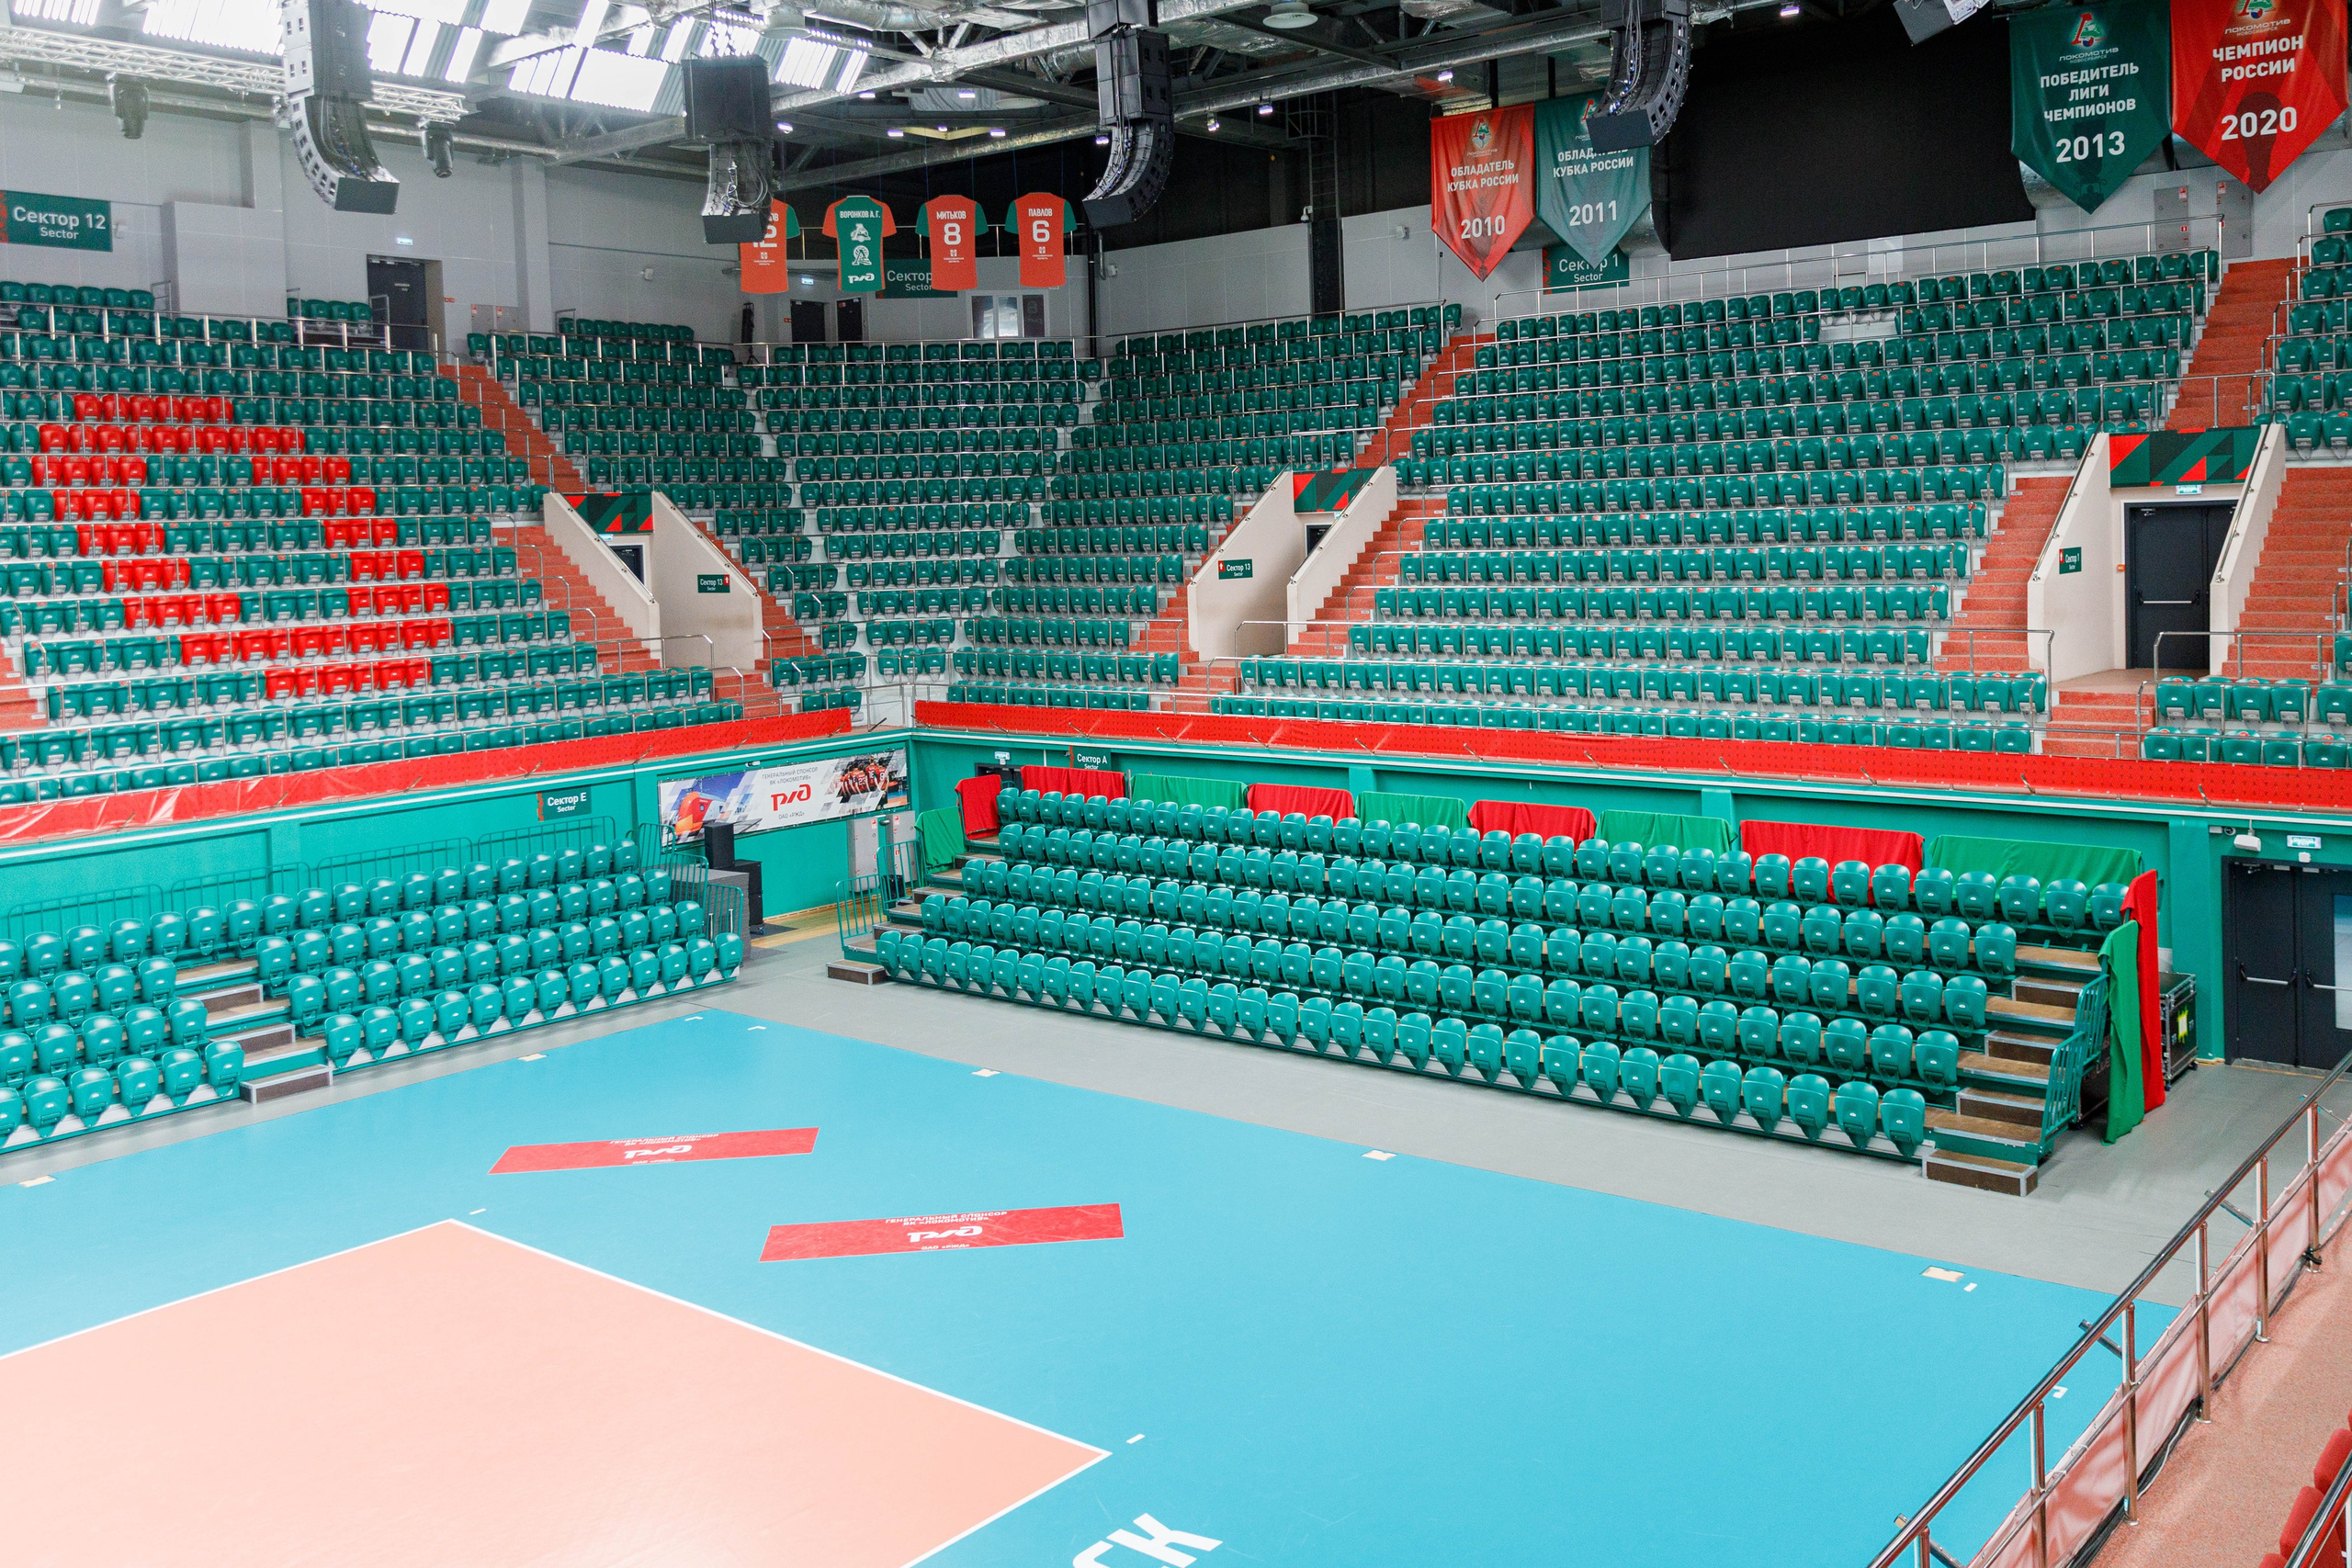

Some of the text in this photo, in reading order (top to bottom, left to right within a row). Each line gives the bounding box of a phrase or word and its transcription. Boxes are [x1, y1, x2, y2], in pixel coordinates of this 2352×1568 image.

[2224, 18, 2291, 35] ЛОКОМОТИВ
[2059, 47, 2120, 62] ЛОКОМОТИВ
[2212, 35, 2304, 62] ЧЕМПИОН
[2040, 62, 2140, 88] ПОБЕДИТЕЛЬ
[2222, 58, 2296, 83] РОССИИ
[2068, 84, 2109, 102] ЛИГИ
[2044, 97, 2137, 122] ЧЕМПИОНОВ
[2221, 107, 2297, 141] 2020
[1557, 147, 1629, 163] ОБЛАД
[2056, 130, 2125, 164] 2013
[1451, 159, 1515, 177] ОБЛАДАТЕЛЬ
[1553, 156, 1634, 178] КУБКА РОССИИ
[1447, 173, 1519, 193] КУБКА РОССИИ
[13, 207, 107, 231] Сектор 12
[840, 210, 870, 219] ВОРОНКОВ
[936, 211, 967, 220] МИТЬКОВ
[1028, 208, 1053, 217] ПАВЛОВ
[1569, 199, 1617, 227] 2011
[40, 227, 80, 240] Sector
[944, 222, 962, 245] 8
[1032, 220, 1050, 243] 6
[1460, 214, 1506, 240] 2010
[752, 224, 778, 248] 2
[1558, 253, 1619, 273] Секр 1
[887, 270, 933, 284] Сектор
[1573, 273, 1603, 283] Sector
[905, 283, 932, 291] Sector
[1226, 562, 1251, 572] Сектор 13
[699, 578, 724, 587] Сектор 13
[1077, 753, 1102, 765] Сектор
[762, 766, 819, 780] ГЕНЕРАЛЬНЫЙ СПОНСОР
[547, 795, 579, 807] Сектор
[557, 805, 577, 813] Sector
[885, 1211, 1008, 1224] ГЕНЕРАЛЬНЫЙ СПОНСОР
